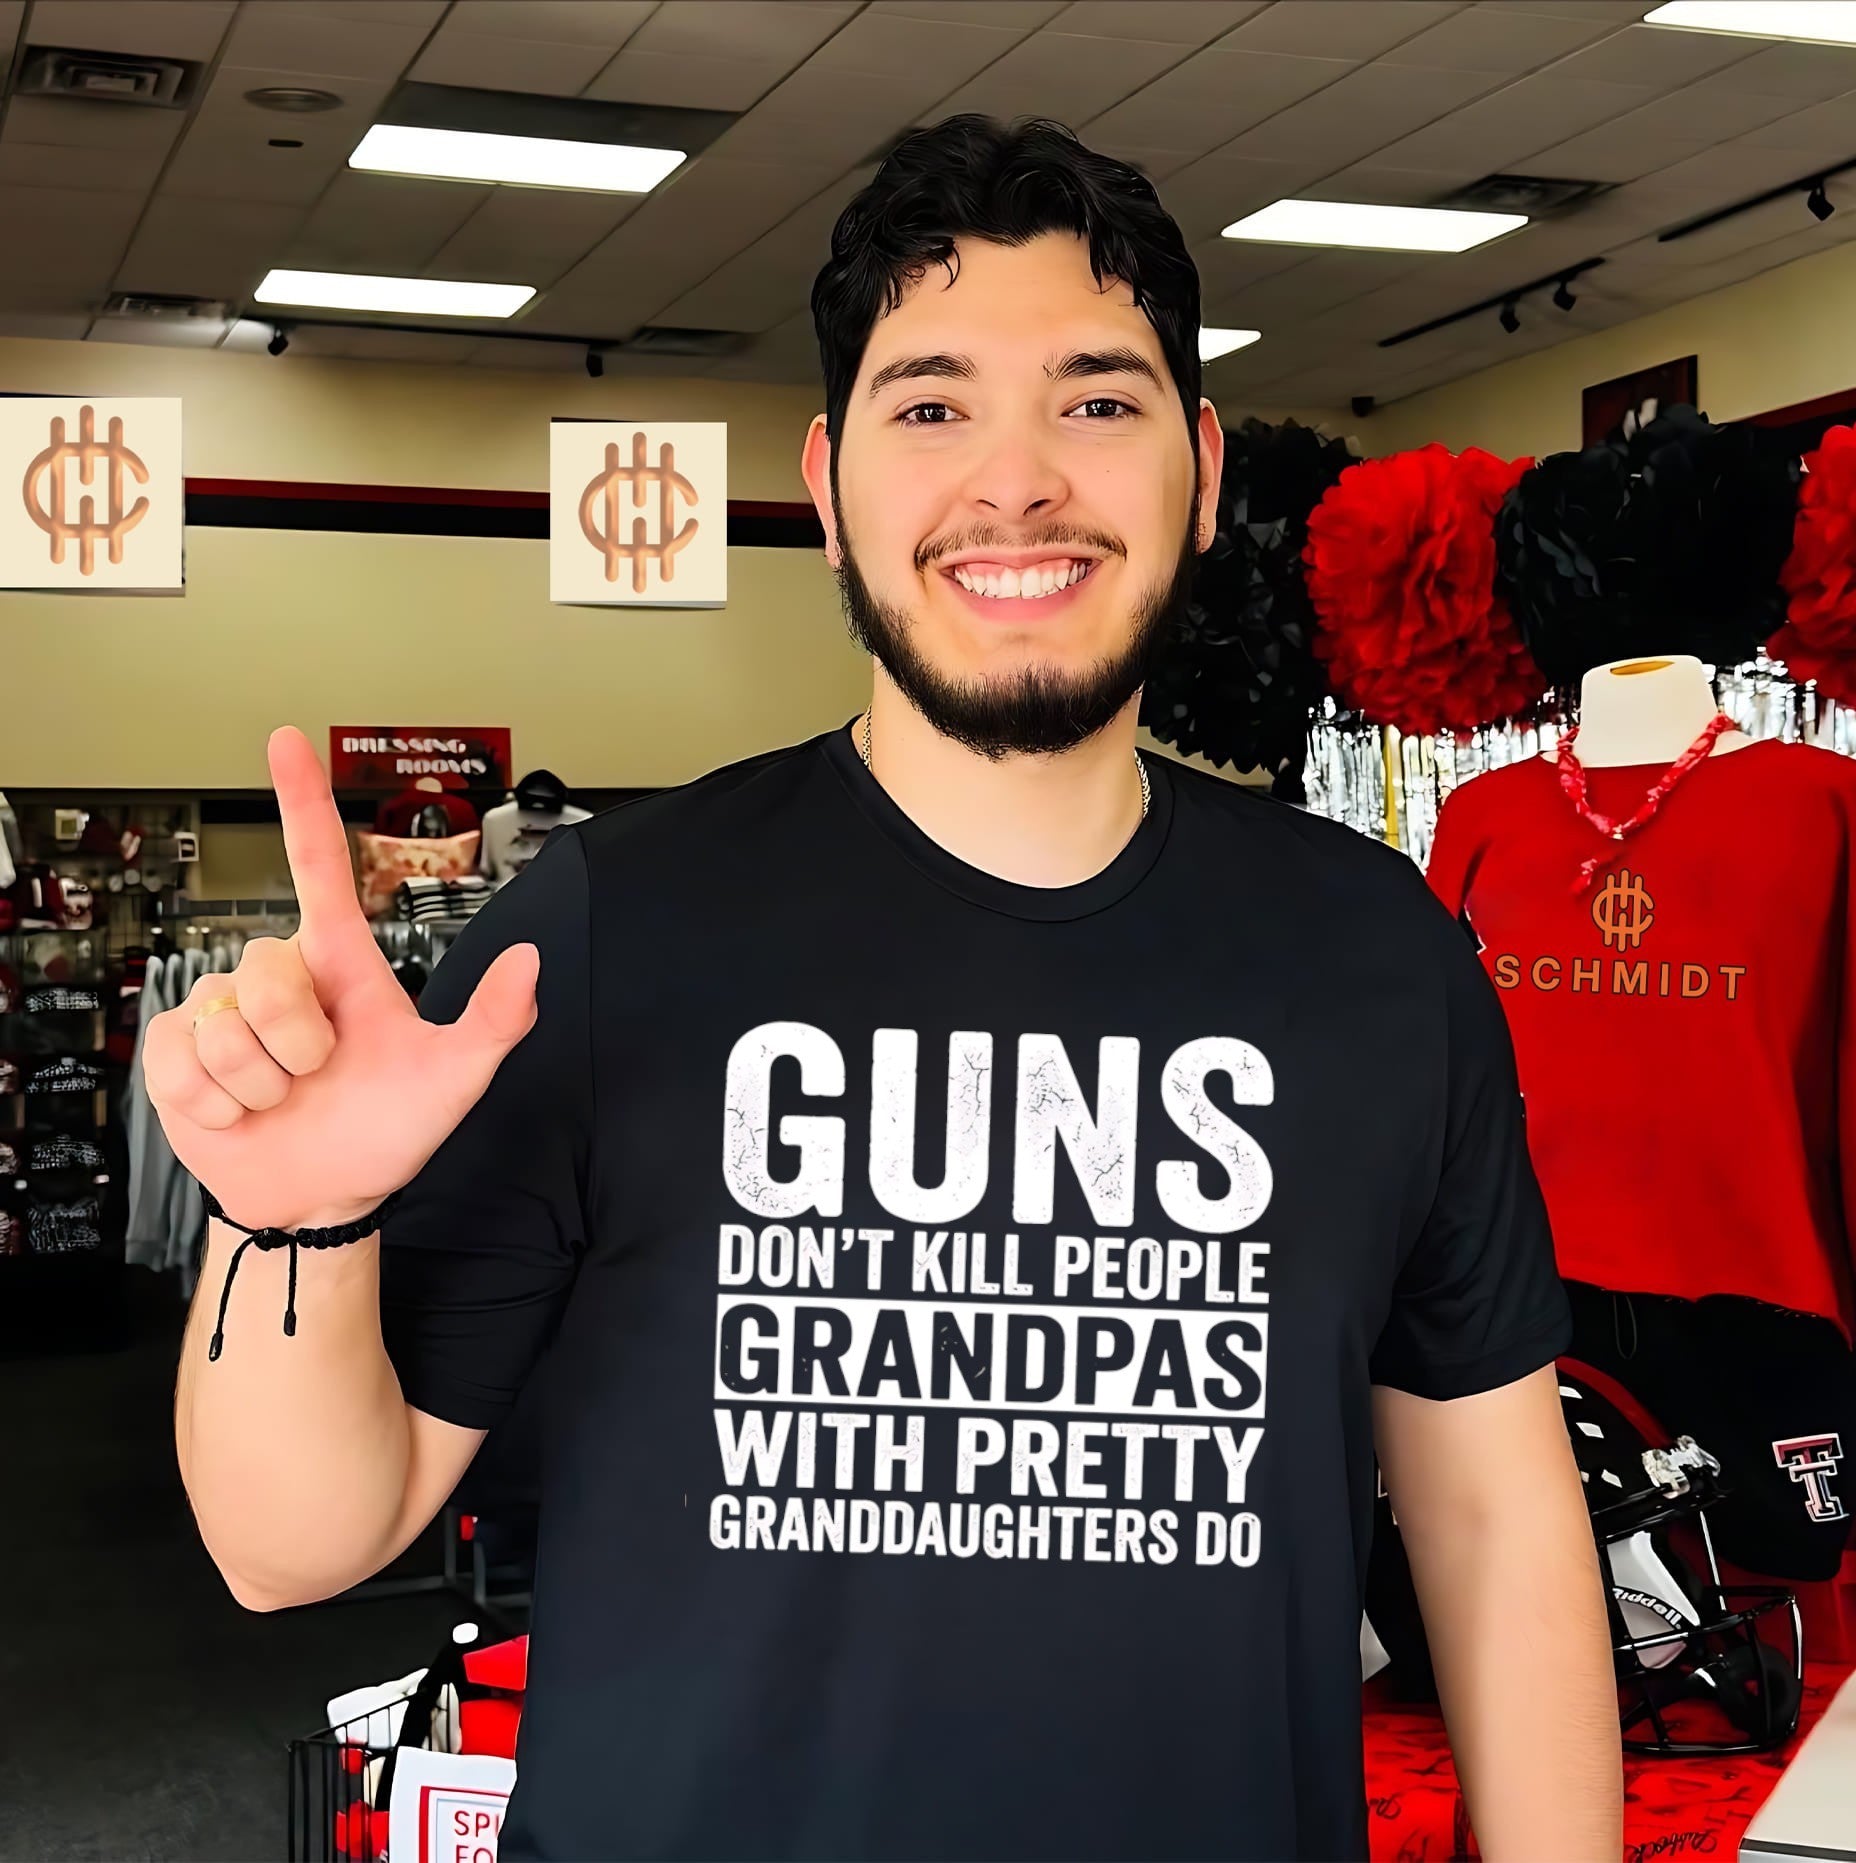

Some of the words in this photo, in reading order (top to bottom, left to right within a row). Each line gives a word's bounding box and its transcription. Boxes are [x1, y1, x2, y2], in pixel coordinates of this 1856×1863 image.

[396, 758, 487, 775] ROOMS
[1494, 954, 1748, 1002] SCHMIDT
[722, 1021, 1274, 1234] GUNS
[718, 1224, 894, 1291] DON'T
[912, 1231, 1033, 1296] KILL
[1055, 1236, 1271, 1304] PEOPLE
[719, 1303, 1264, 1411] GRANDPAS
[714, 1408, 926, 1492] WITH
[956, 1417, 1265, 1503] PRETTY
[709, 1494, 1179, 1565] GRANDDAUGHTERS
[1195, 1511, 1262, 1568] DO
